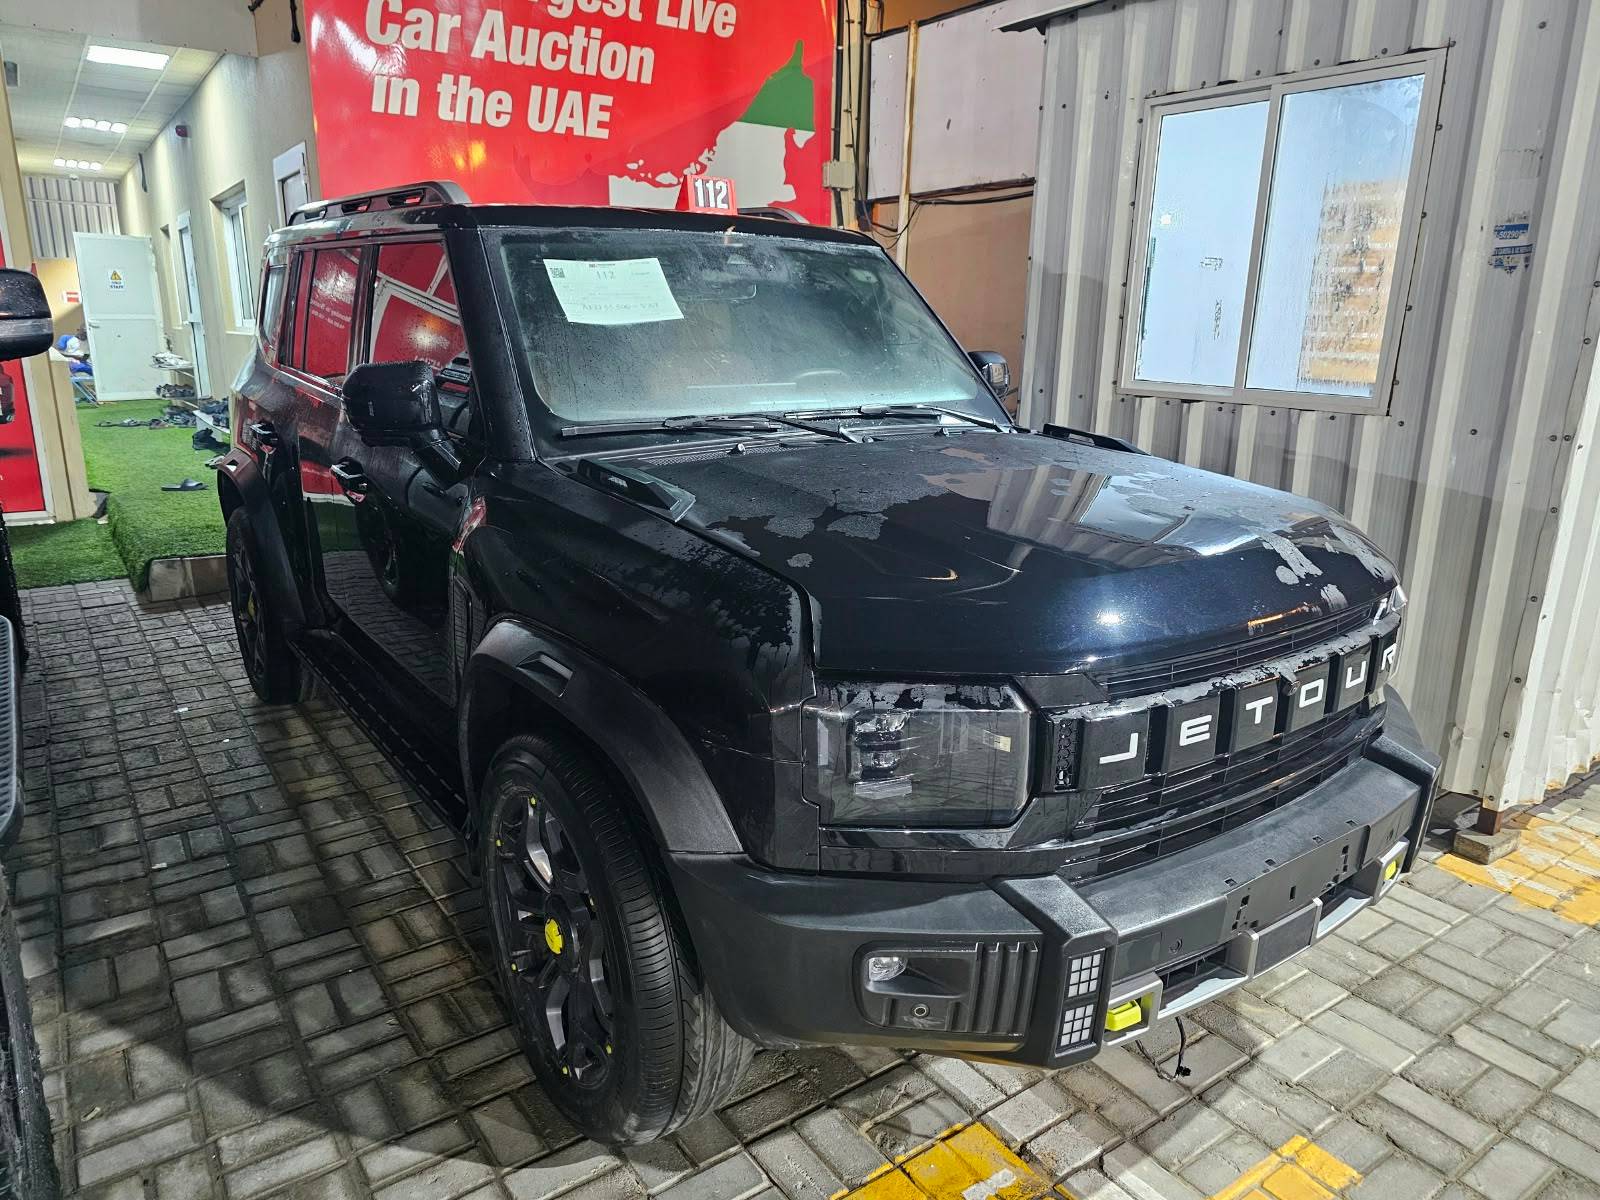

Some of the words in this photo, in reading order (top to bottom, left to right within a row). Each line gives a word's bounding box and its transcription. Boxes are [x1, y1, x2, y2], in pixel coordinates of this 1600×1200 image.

[365, 0, 461, 53] Car
[471, 9, 655, 84] Auction
[656, 0, 737, 38] Live
[371, 73, 420, 117] in
[437, 73, 513, 127] the
[527, 85, 614, 139] UAE
[695, 179, 729, 209] 112
[1100, 643, 1397, 764] JETOUR
